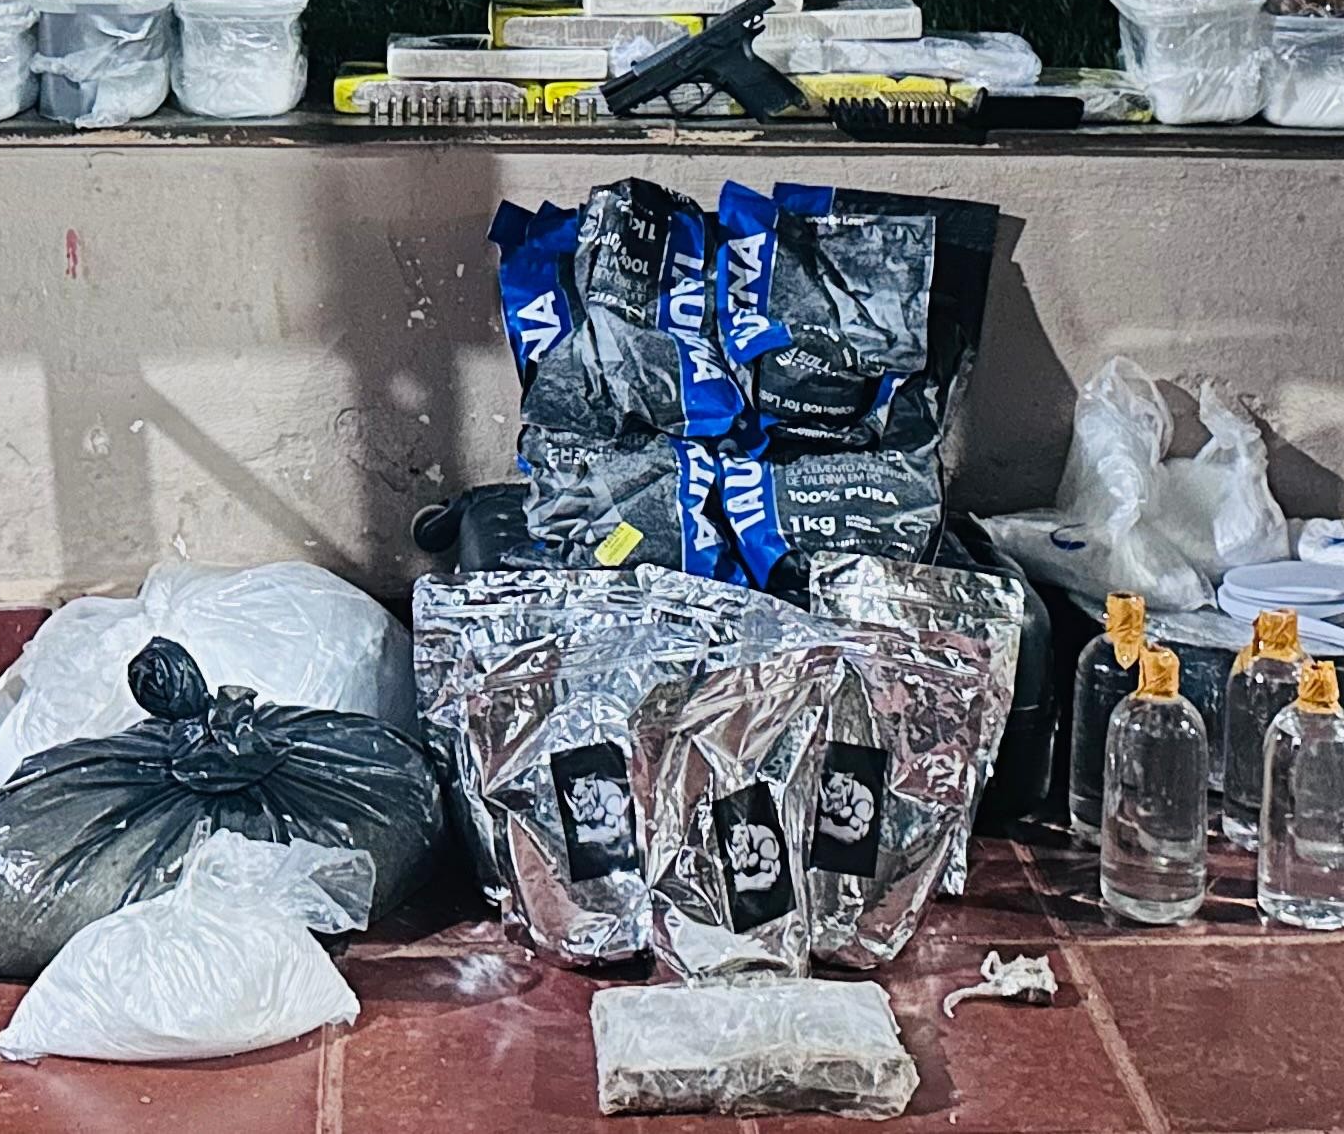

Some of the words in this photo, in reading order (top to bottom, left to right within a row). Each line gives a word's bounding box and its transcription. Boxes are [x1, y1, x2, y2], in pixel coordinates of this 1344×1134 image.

[782, 398, 801, 413] for
[788, 489, 840, 504] 100%
[845, 486, 899, 505] PURA
[789, 515, 836, 536] 1kg
